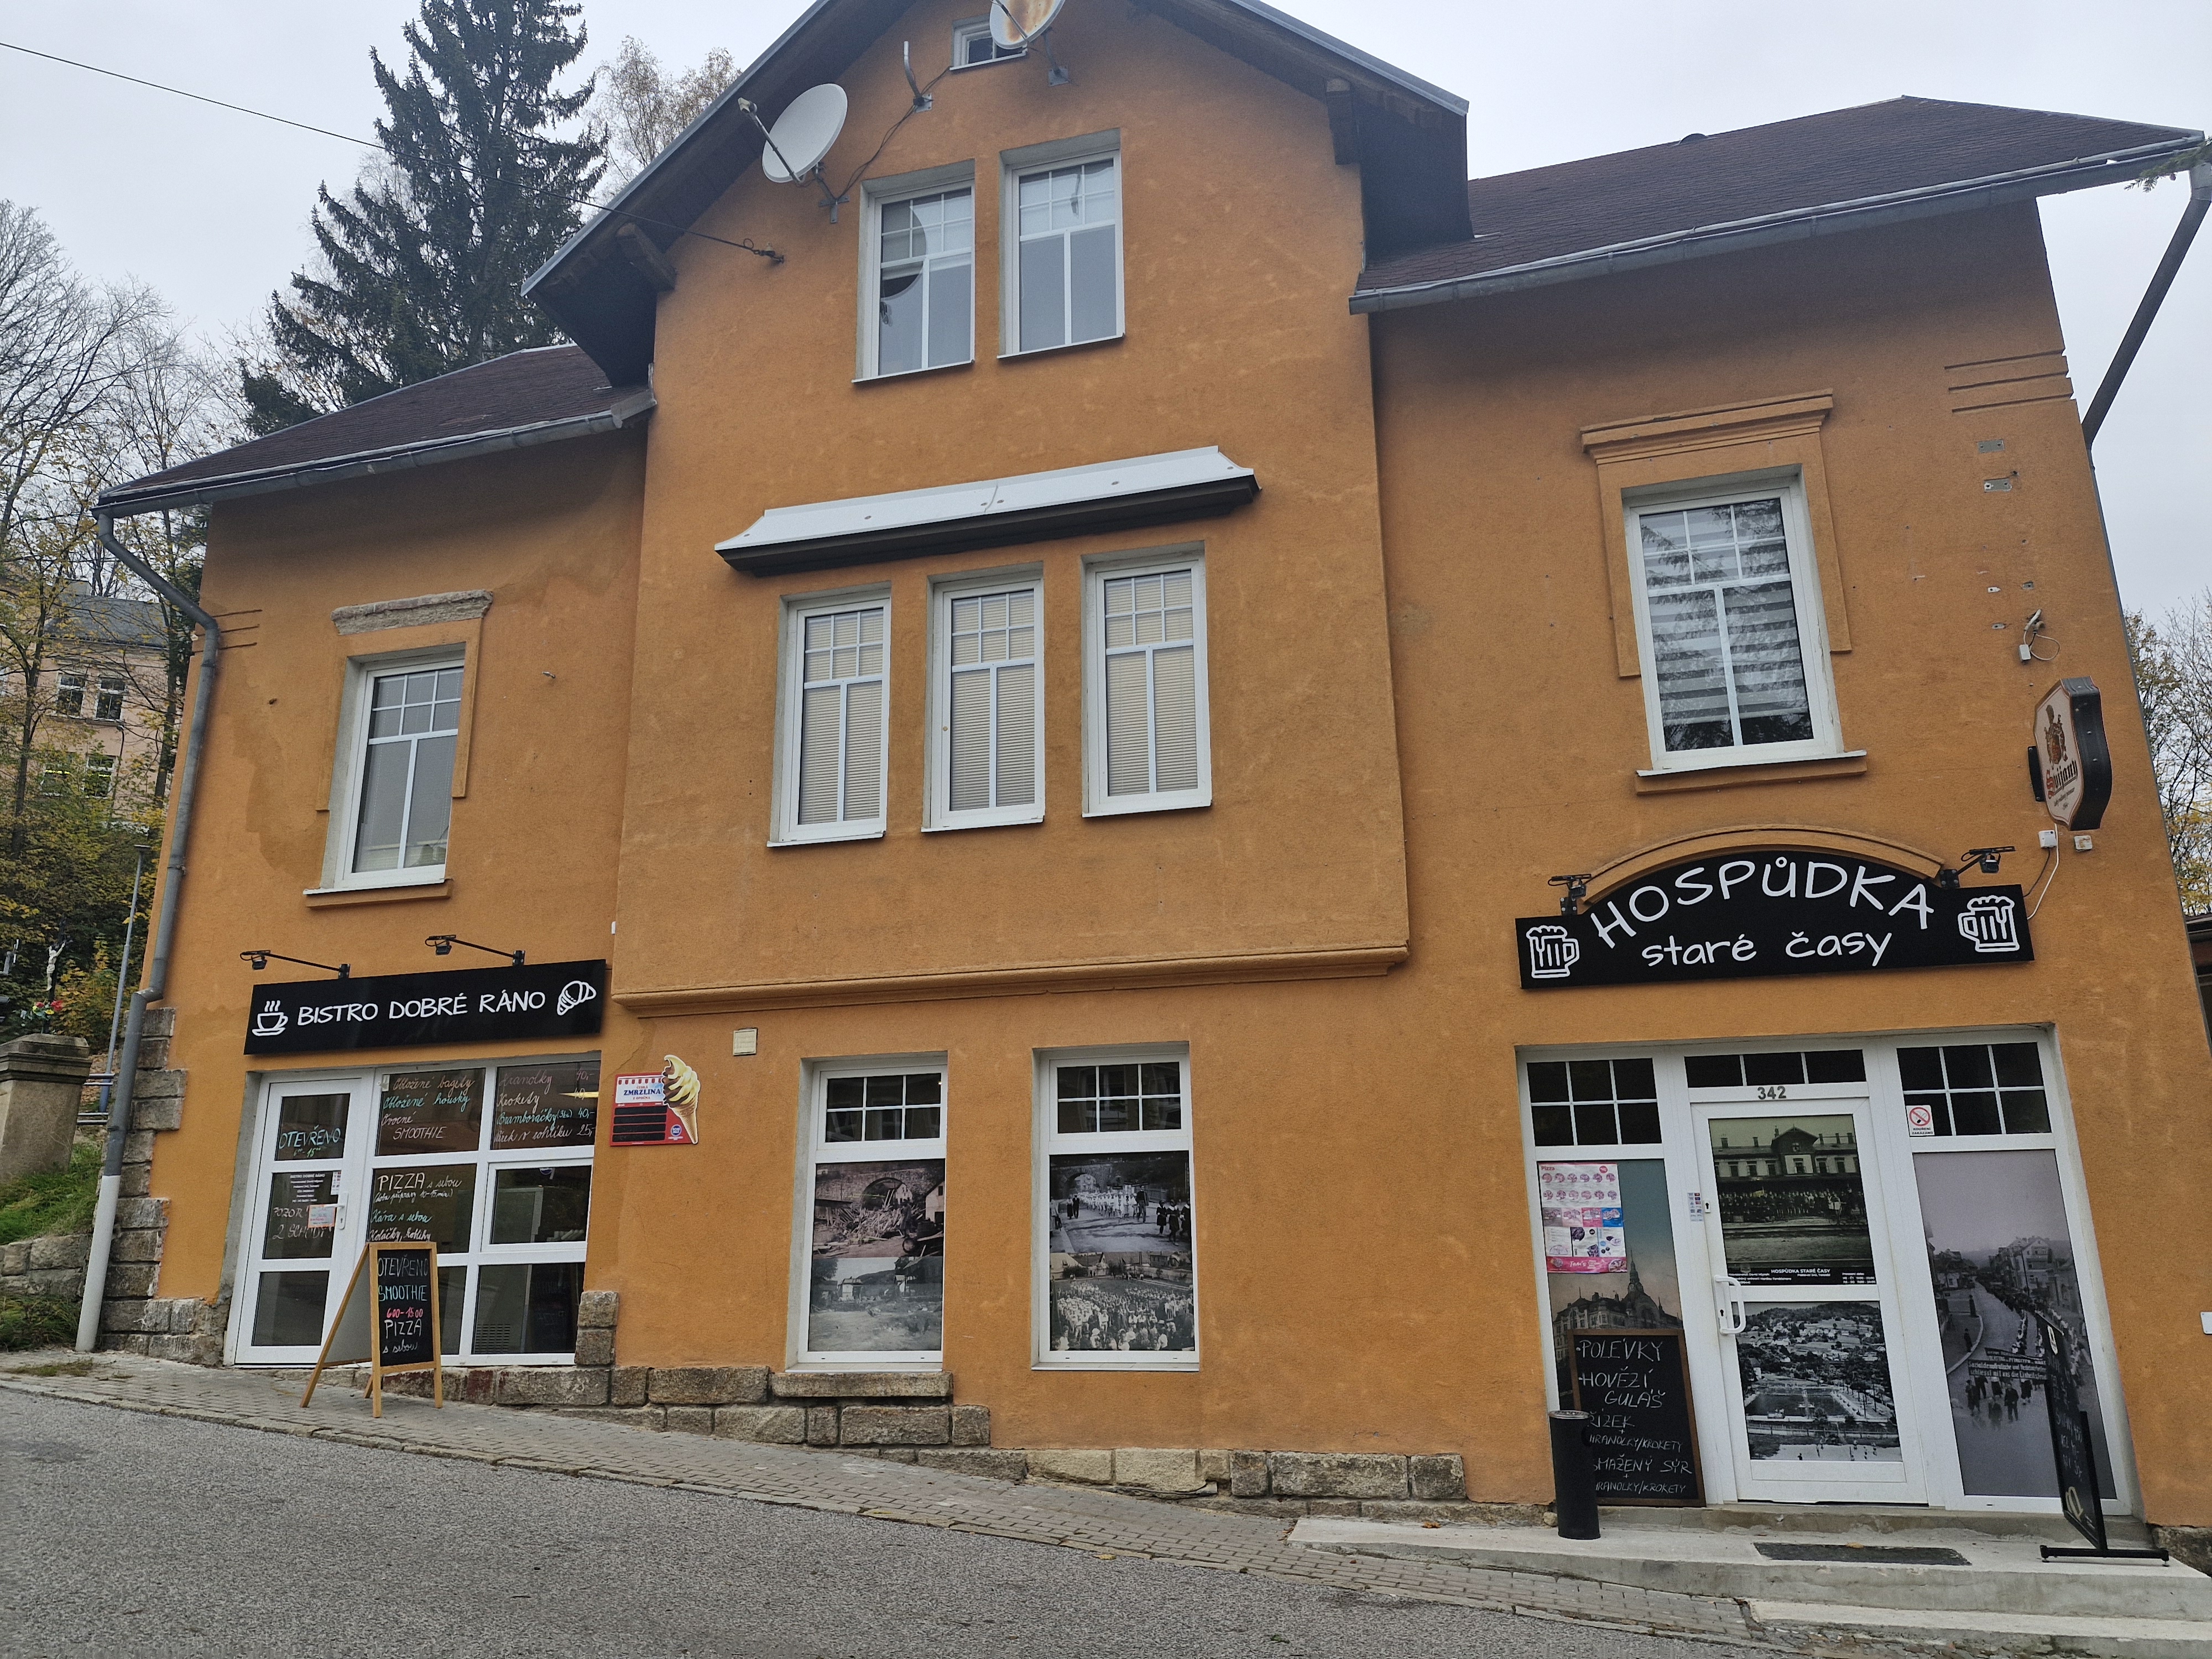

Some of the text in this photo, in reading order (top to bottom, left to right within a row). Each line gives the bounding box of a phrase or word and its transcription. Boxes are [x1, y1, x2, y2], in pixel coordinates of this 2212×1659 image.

[1590, 857, 1934, 948] HOSPŮDKA
[1642, 931, 1892, 967] staré časy
[298, 989, 545, 1026] BISTRO DOBRÉ RÁNO
[1757, 1086, 1787, 1100] 342
[279, 1124, 341, 1149] OTEVŘENO
[393, 1125, 447, 1140] SMOOTHIE
[377, 1172, 426, 1191] PIZZA
[435, 1175, 463, 1188] sebou
[272, 1224, 284, 1239] 2
[377, 1253, 429, 1277] OTEVŘENO
[378, 1284, 427, 1302] SMOOTHIE
[384, 1318, 422, 1339] PIZZA
[392, 1338, 418, 1354] sebou
[1604, 1388, 1666, 1408] GULÁŠ
[1660, 1458, 1693, 1474] SÝR
